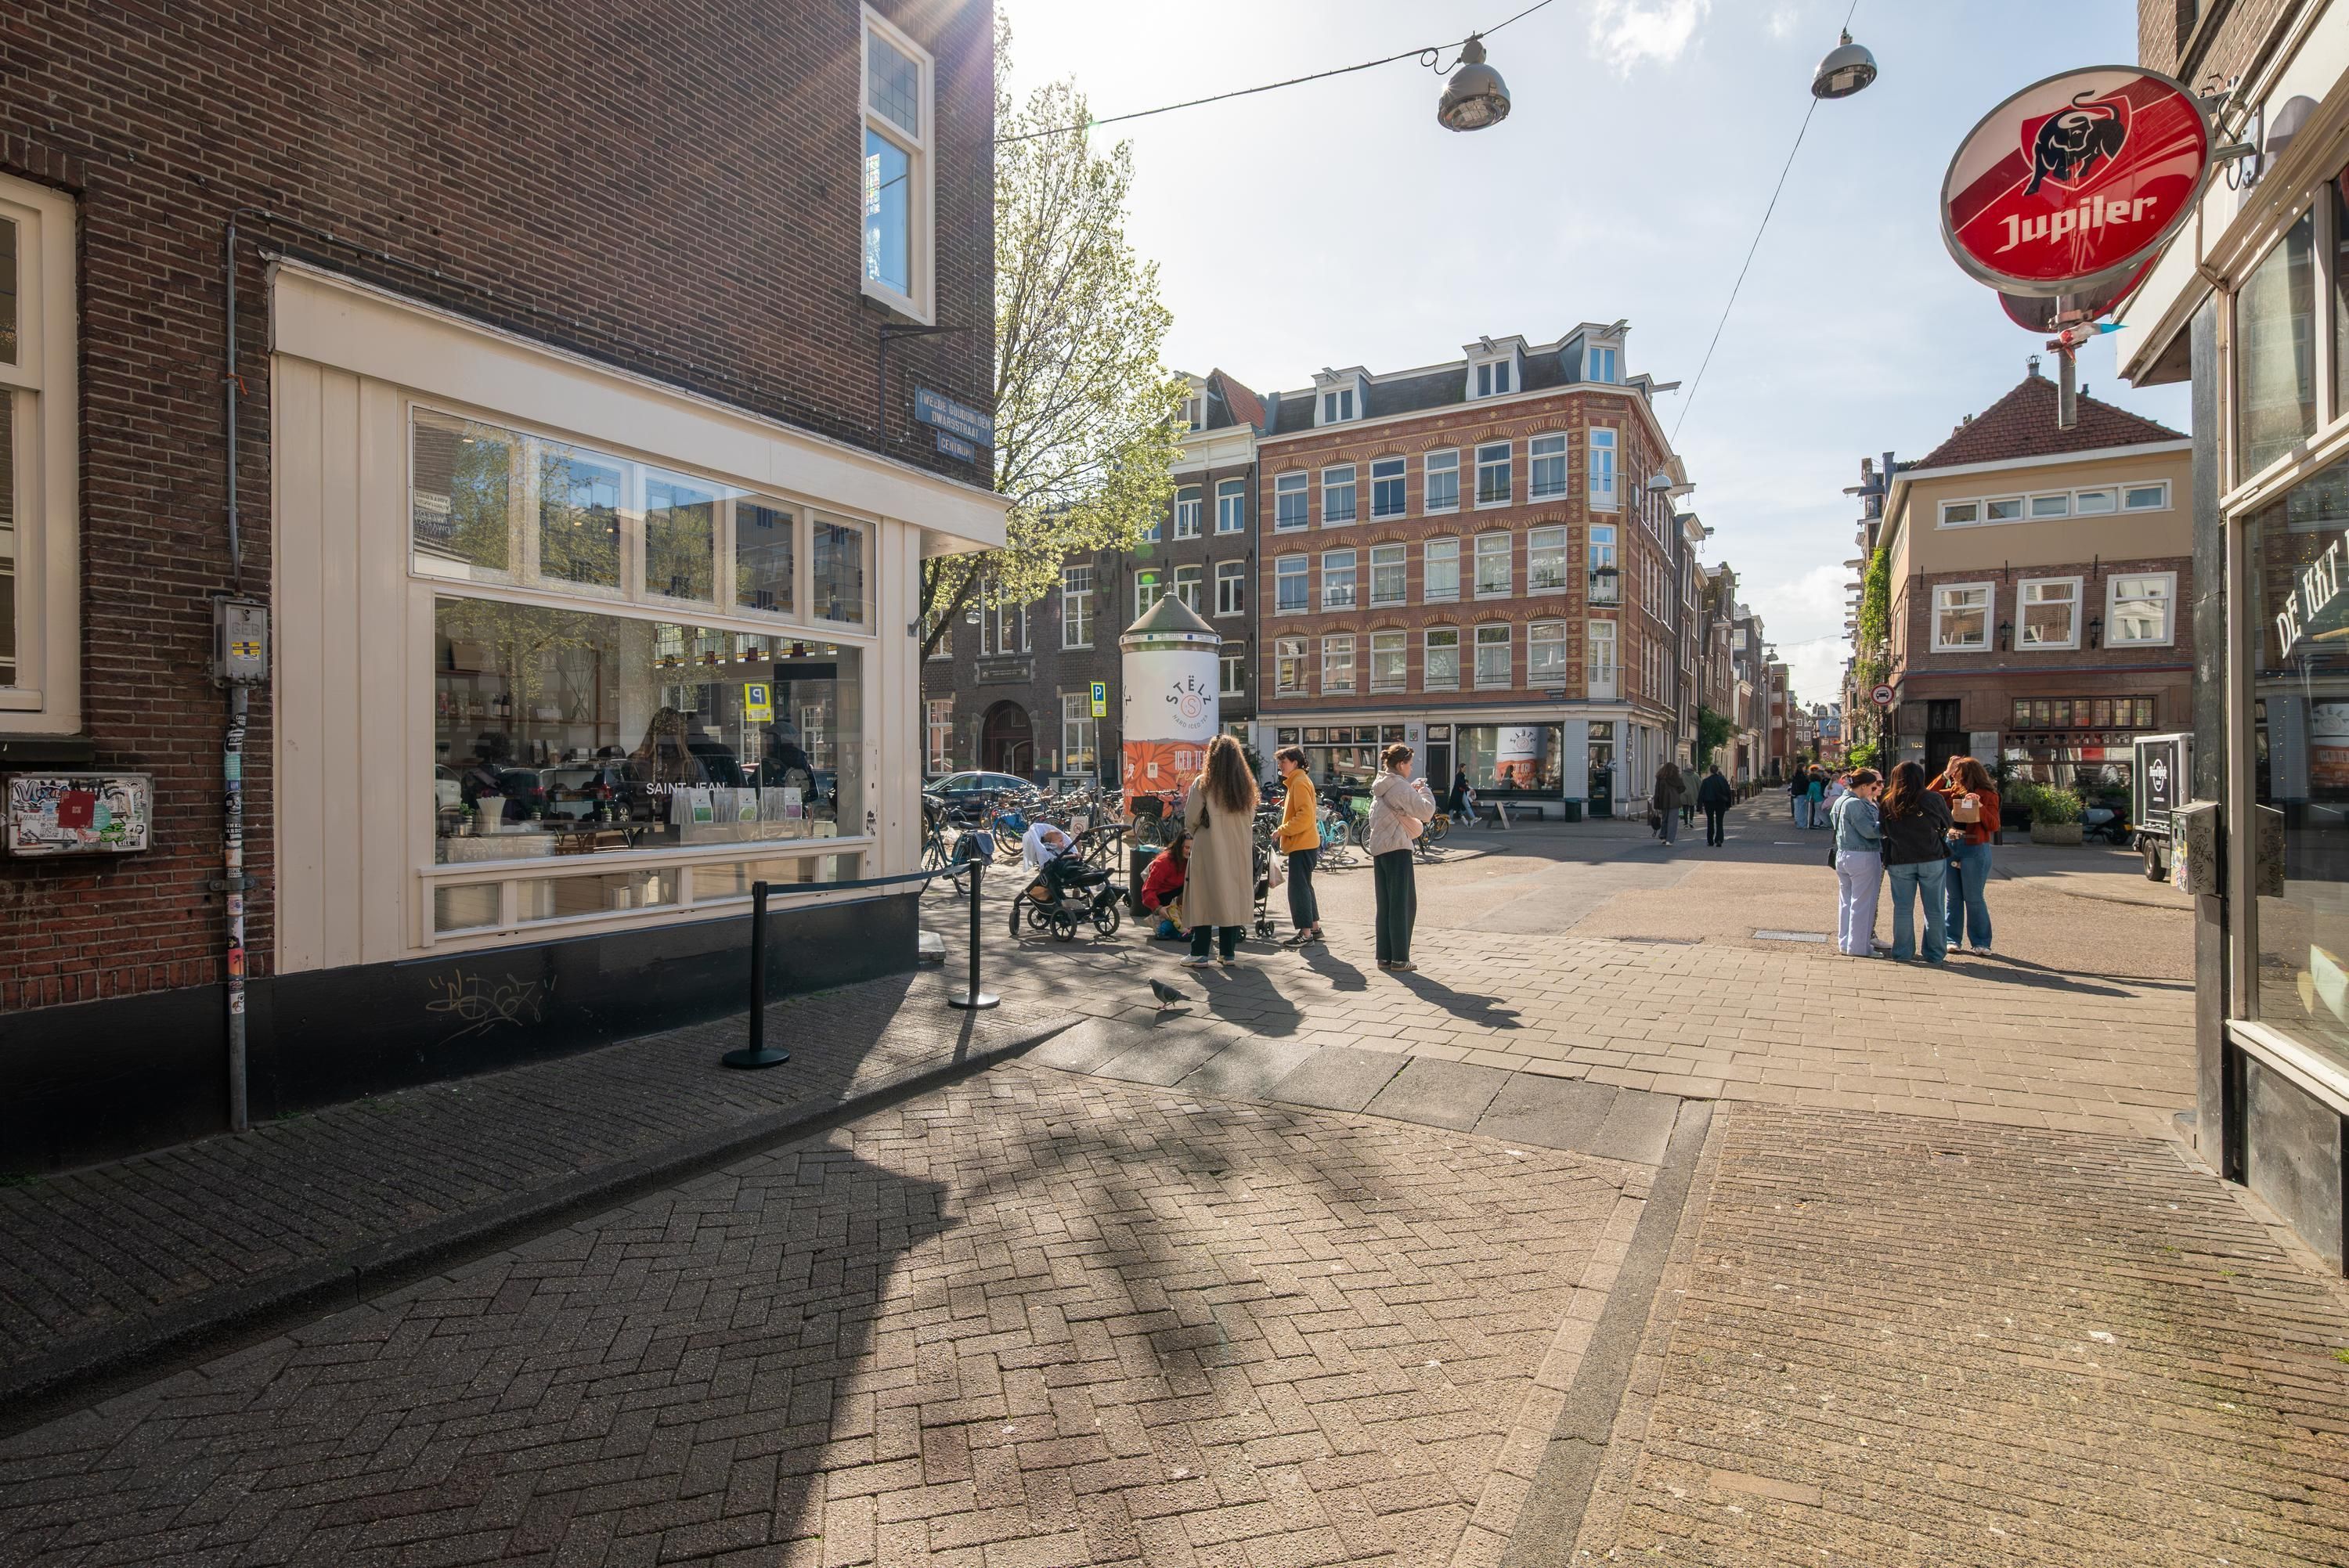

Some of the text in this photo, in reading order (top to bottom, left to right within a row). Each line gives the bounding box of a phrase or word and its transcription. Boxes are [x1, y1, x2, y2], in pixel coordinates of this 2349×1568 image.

[1993, 195, 2158, 254] Jupiler
[919, 391, 947, 413] TWEEDE
[932, 411, 979, 439] DWARSSTRAAT
[940, 438, 972, 458] CENTRUM
[2276, 539, 2339, 659] DE KAT
[1095, 686, 1102, 700] P
[1166, 675, 1211, 705] STËLZ
[1172, 714, 1187, 728] HARD
[1174, 751, 1192, 770] ICED
